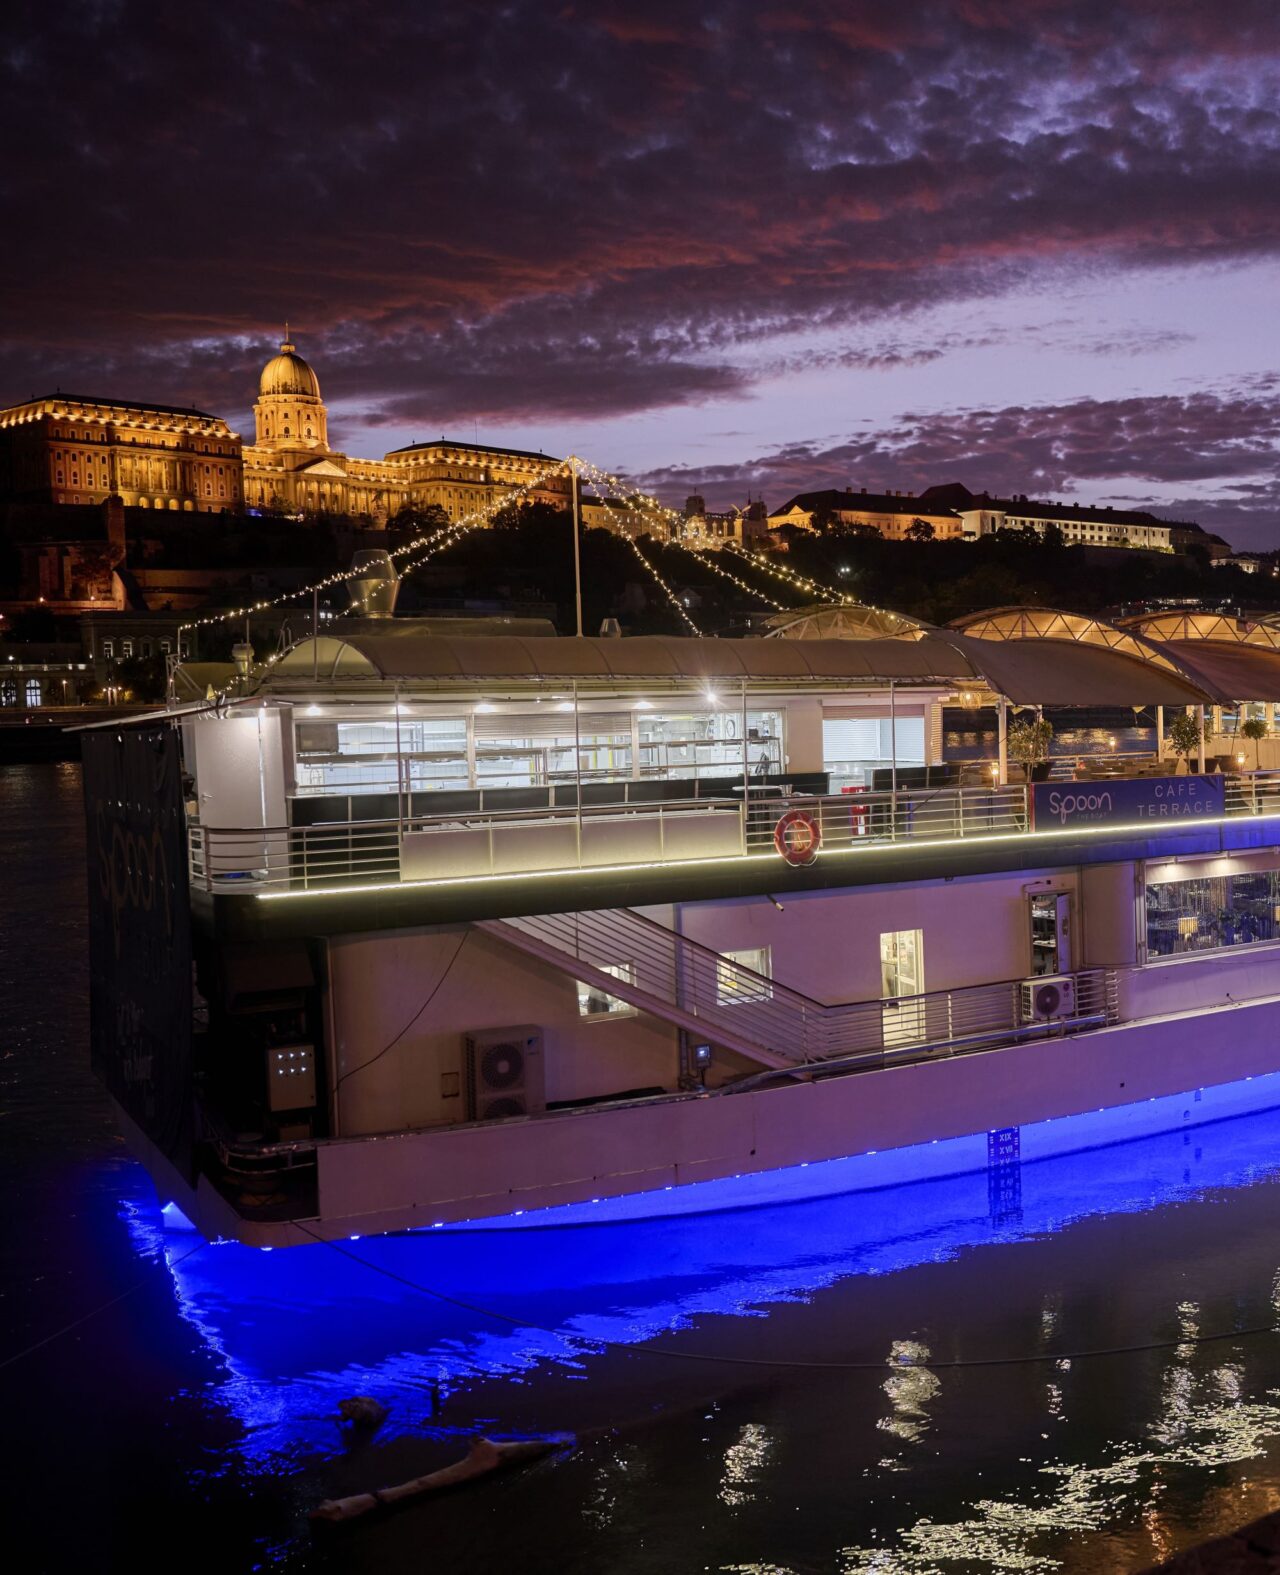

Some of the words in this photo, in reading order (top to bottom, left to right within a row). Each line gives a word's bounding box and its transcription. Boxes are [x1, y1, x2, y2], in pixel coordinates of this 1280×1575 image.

[1154, 783, 1197, 798] CAFE
[1049, 791, 1112, 825] Spoon
[1137, 800, 1214, 817] TERRACE
[999, 1132, 1012, 1142] XIX
